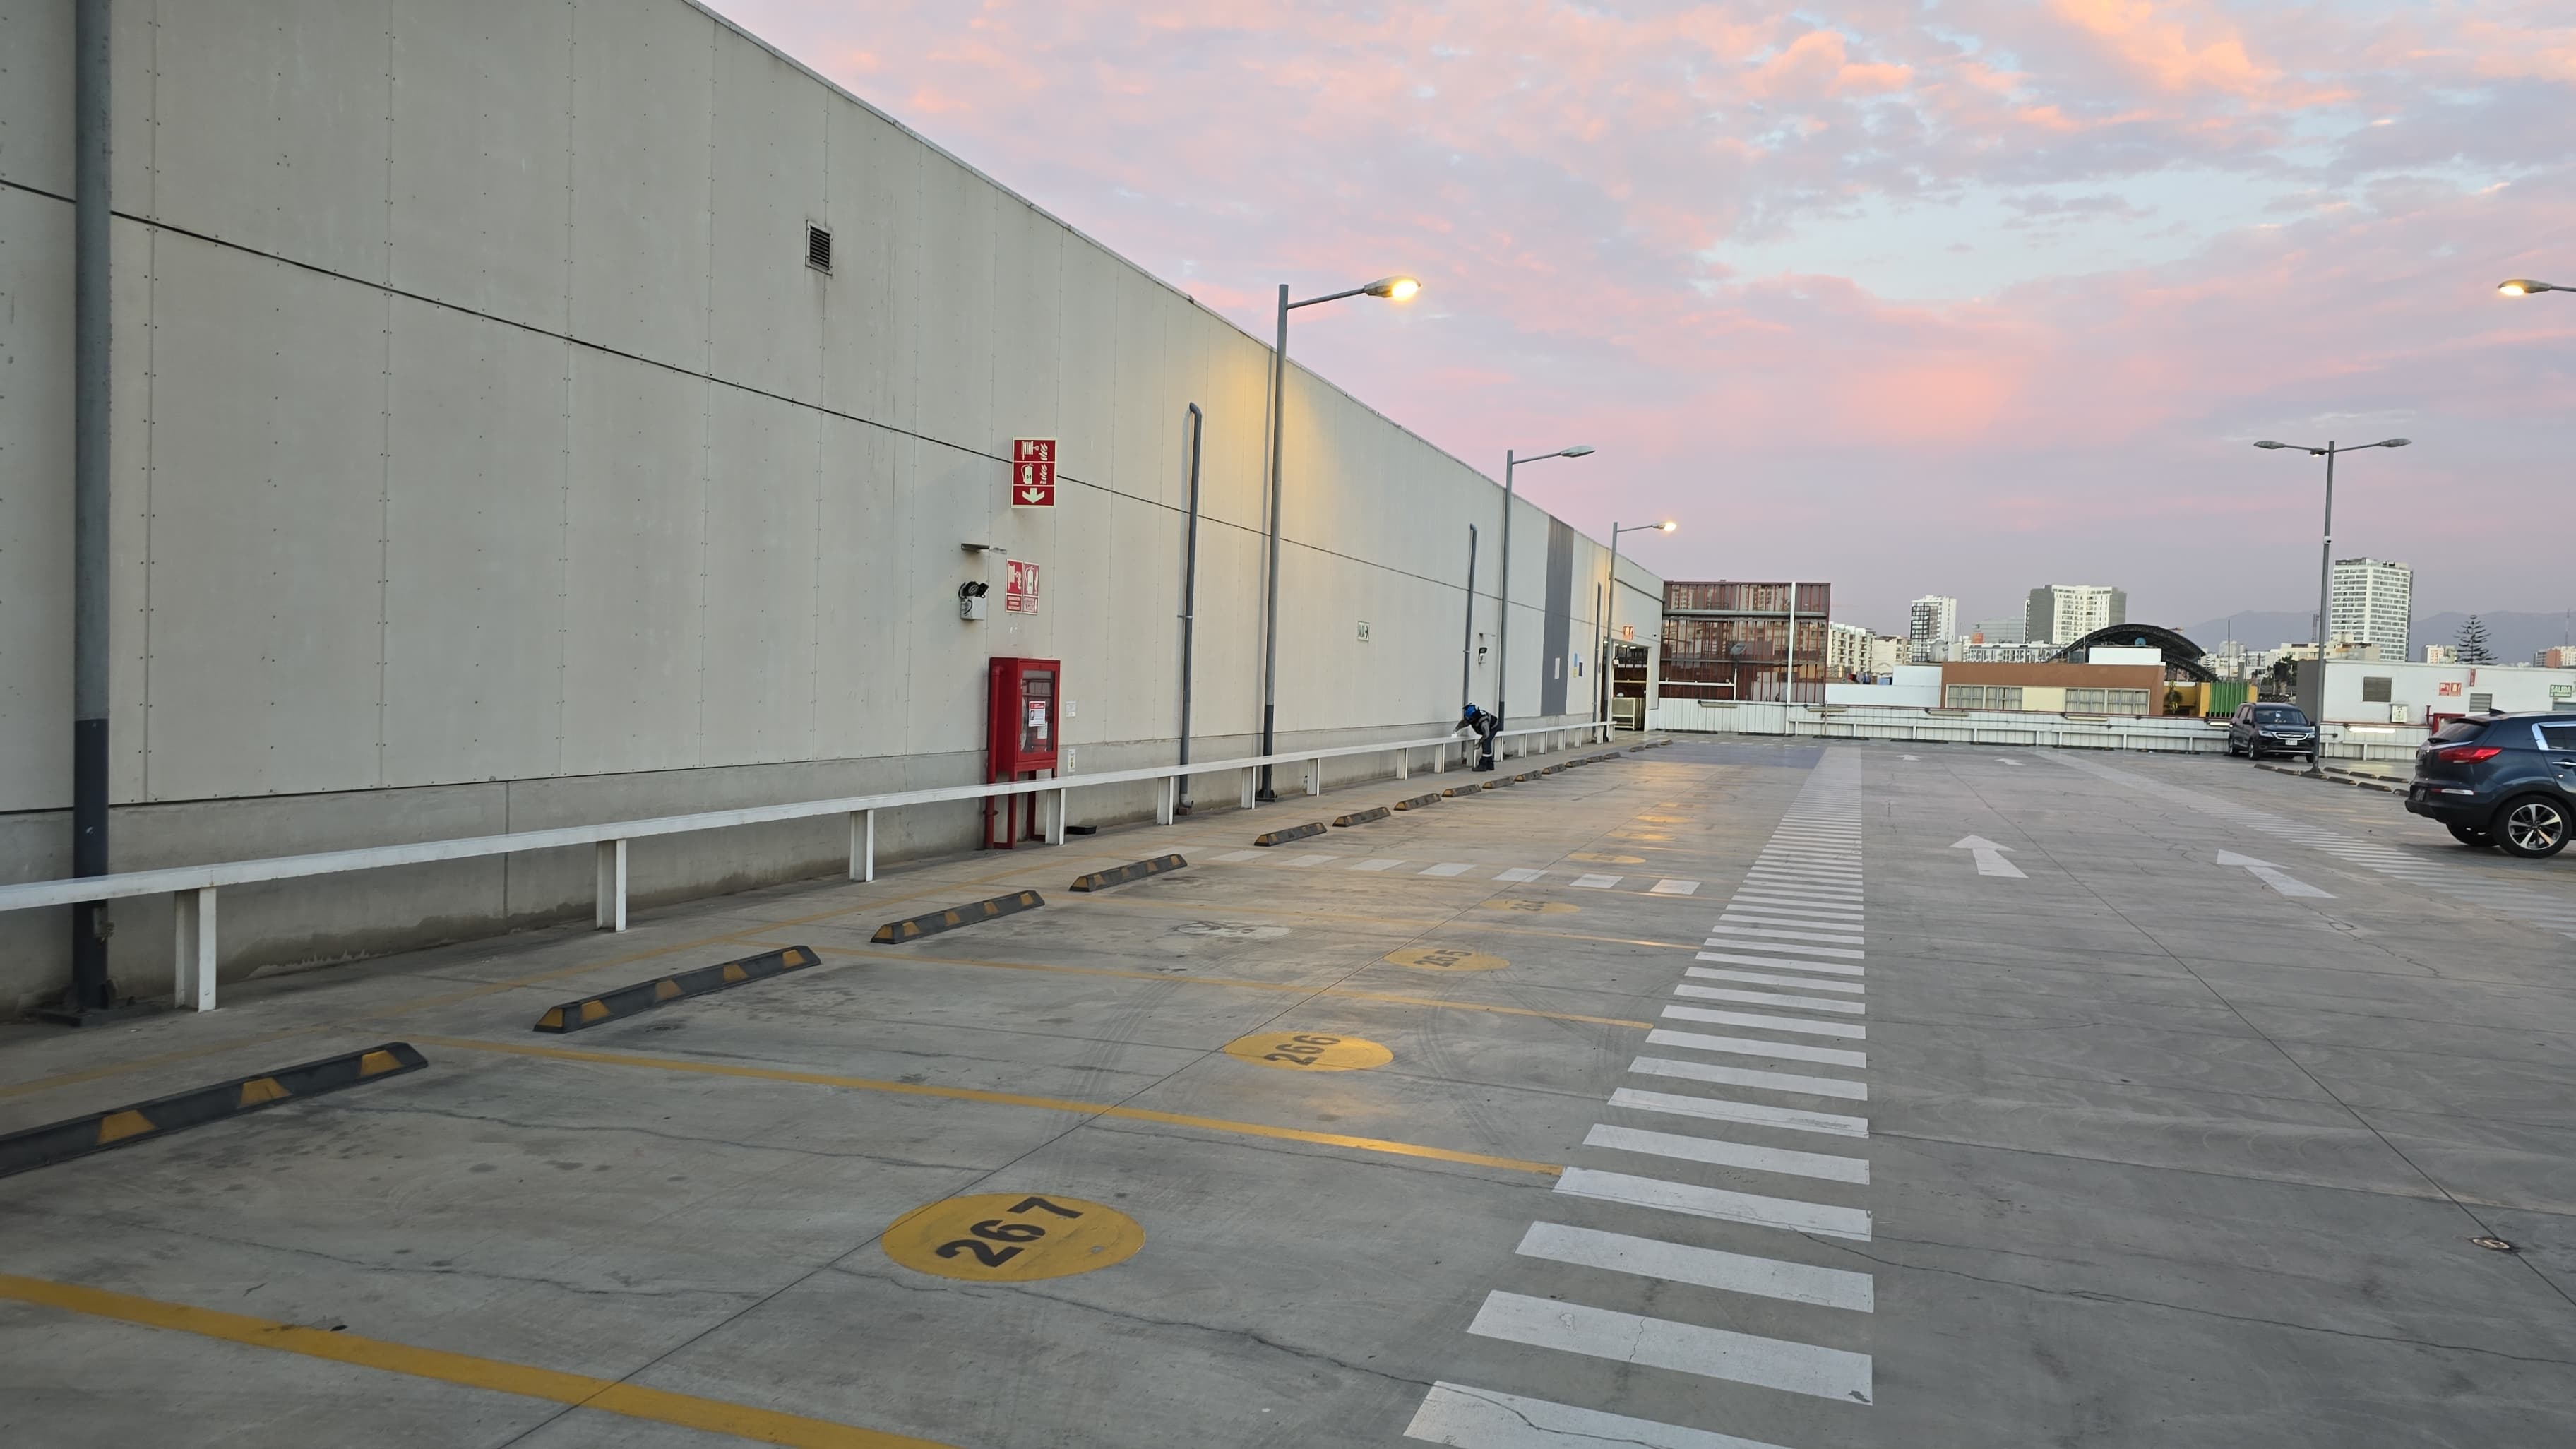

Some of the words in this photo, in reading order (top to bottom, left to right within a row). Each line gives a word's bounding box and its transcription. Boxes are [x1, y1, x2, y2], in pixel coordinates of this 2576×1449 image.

[1412, 950, 1472, 967] 265
[1264, 1035, 1340, 1066] 266
[935, 1197, 1084, 1268] 267
